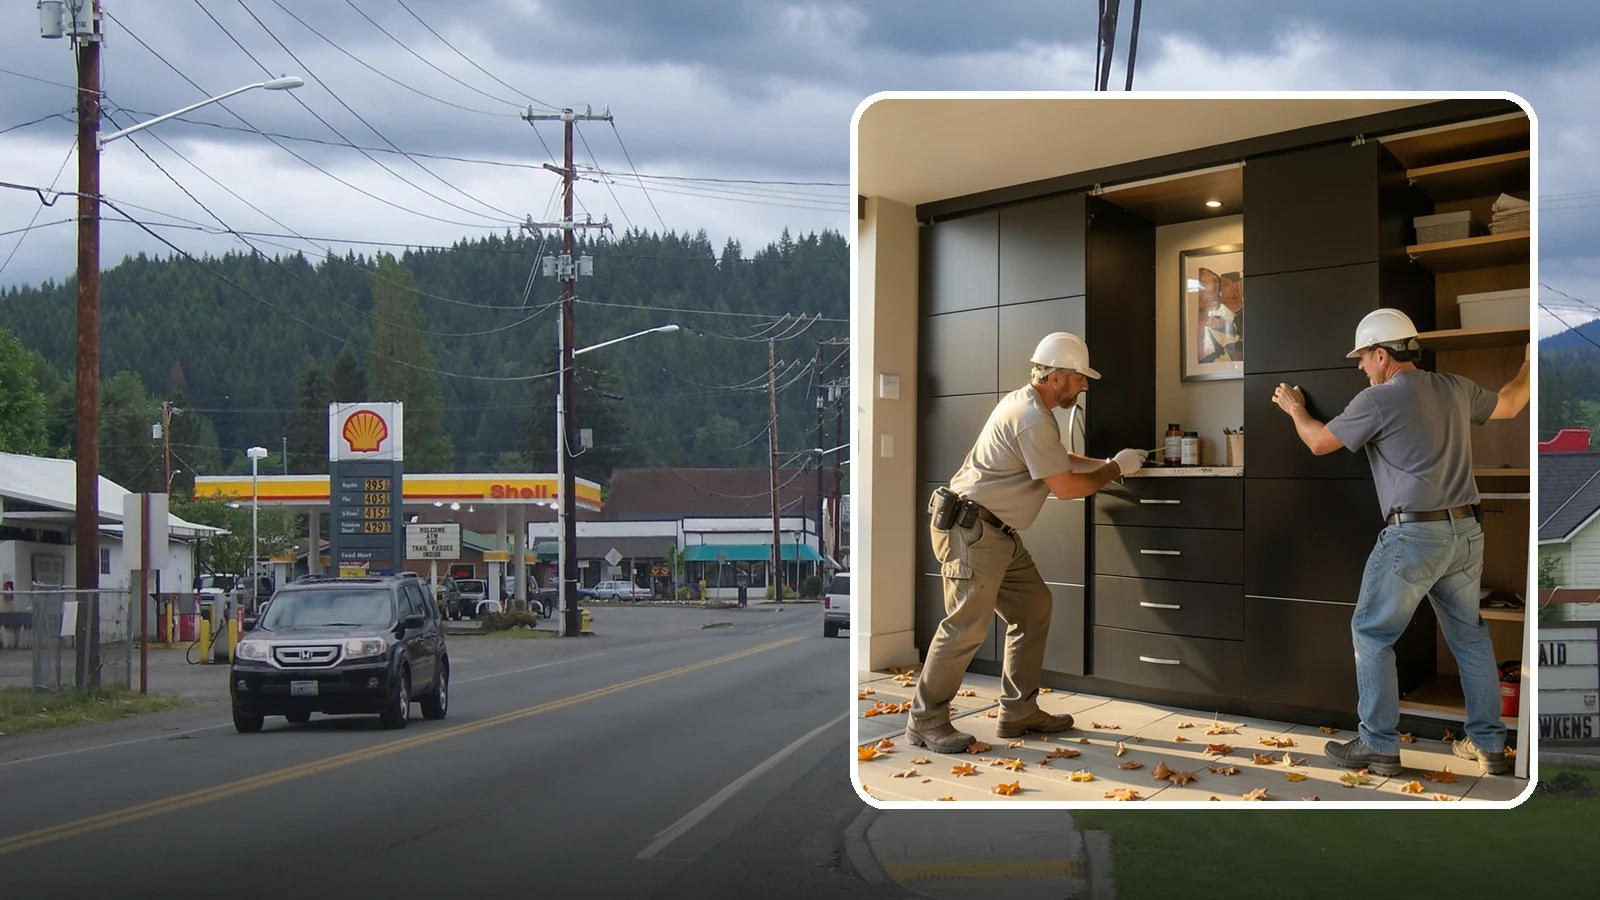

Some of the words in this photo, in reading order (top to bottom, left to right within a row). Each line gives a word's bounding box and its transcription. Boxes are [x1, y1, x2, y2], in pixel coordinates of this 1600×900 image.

[366, 480, 384, 490] 395
[490, 484, 547, 499] Shell
[366, 494, 384, 504] 405
[366, 508, 383, 518] 415
[366, 522, 384, 532] 429
